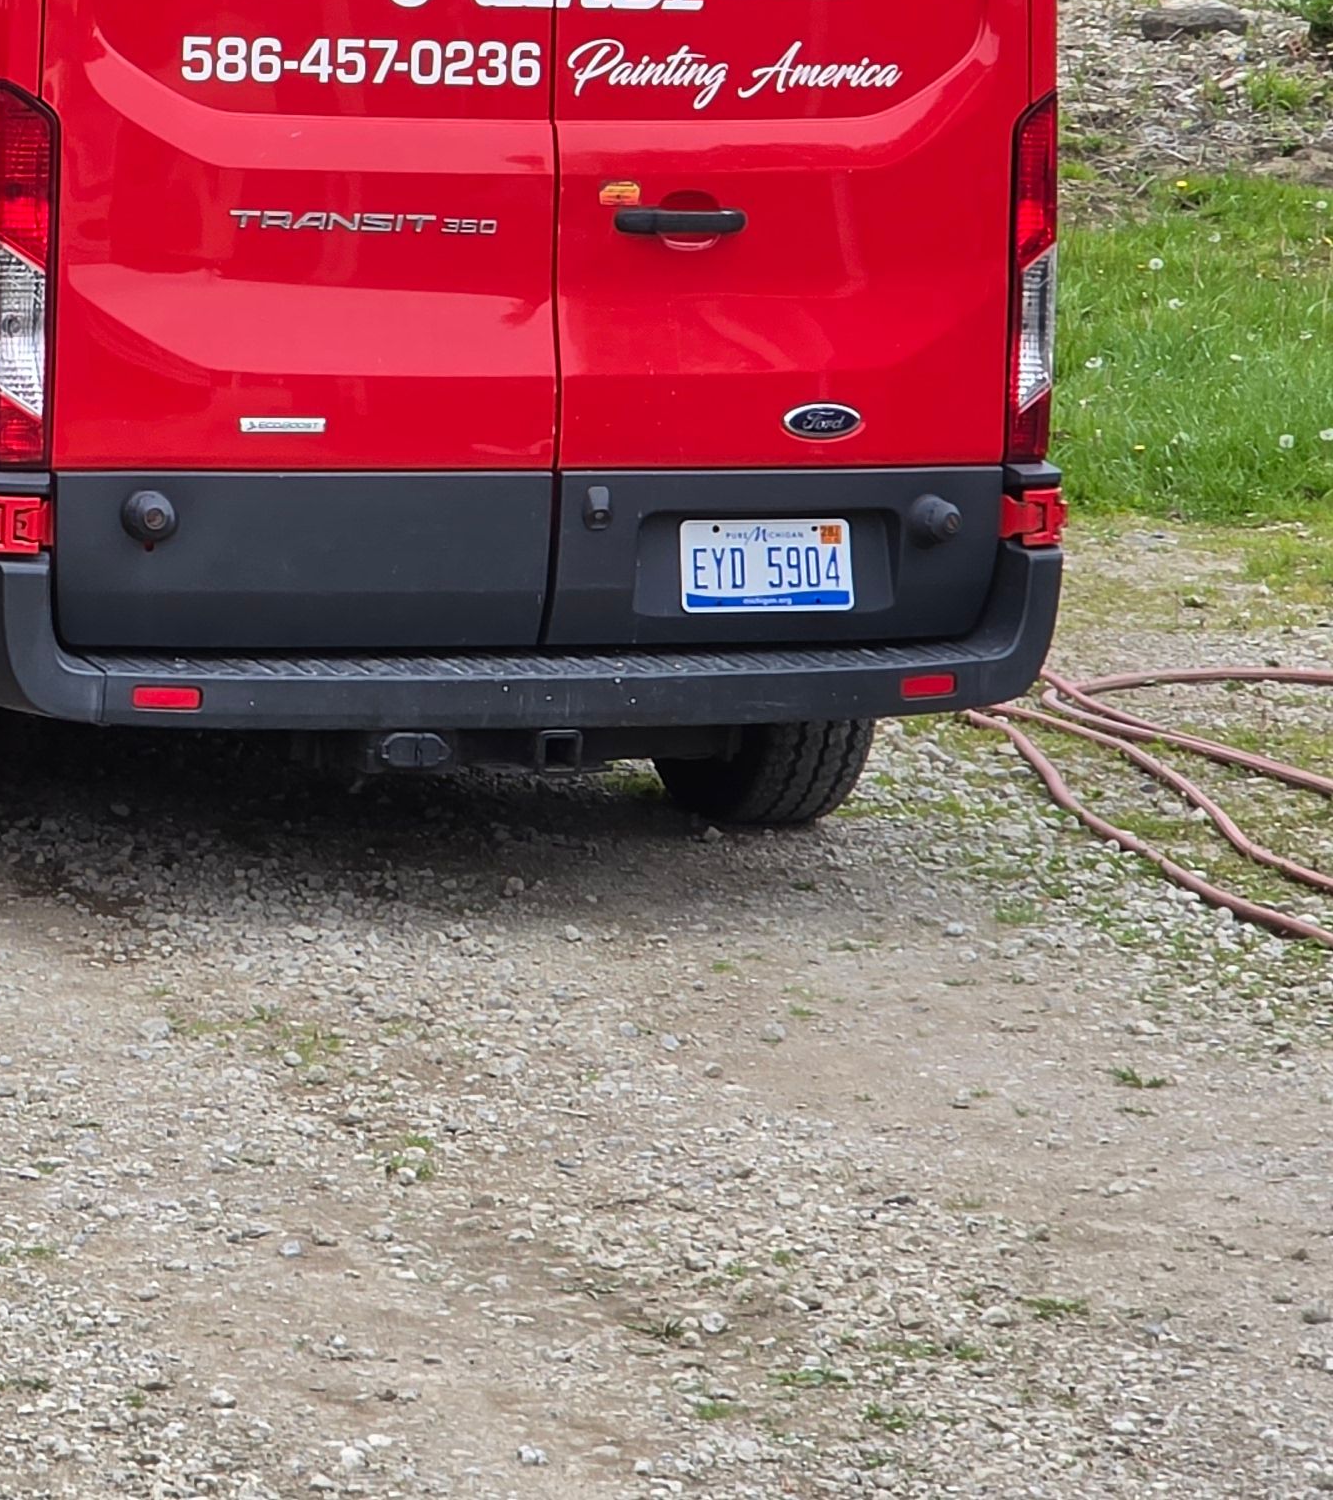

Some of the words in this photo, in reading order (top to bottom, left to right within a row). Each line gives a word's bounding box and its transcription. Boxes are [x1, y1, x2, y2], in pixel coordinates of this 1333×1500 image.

[180, 36, 542, 86] 586-457-0236
[566, 39, 727, 109] Painting
[738, 41, 904, 98] America
[230, 210, 437, 232] TRANSIT
[441, 218, 498, 234] 350
[802, 411, 846, 430] Ford
[693, 548, 745, 590] EYD
[767, 547, 840, 589] 5904
